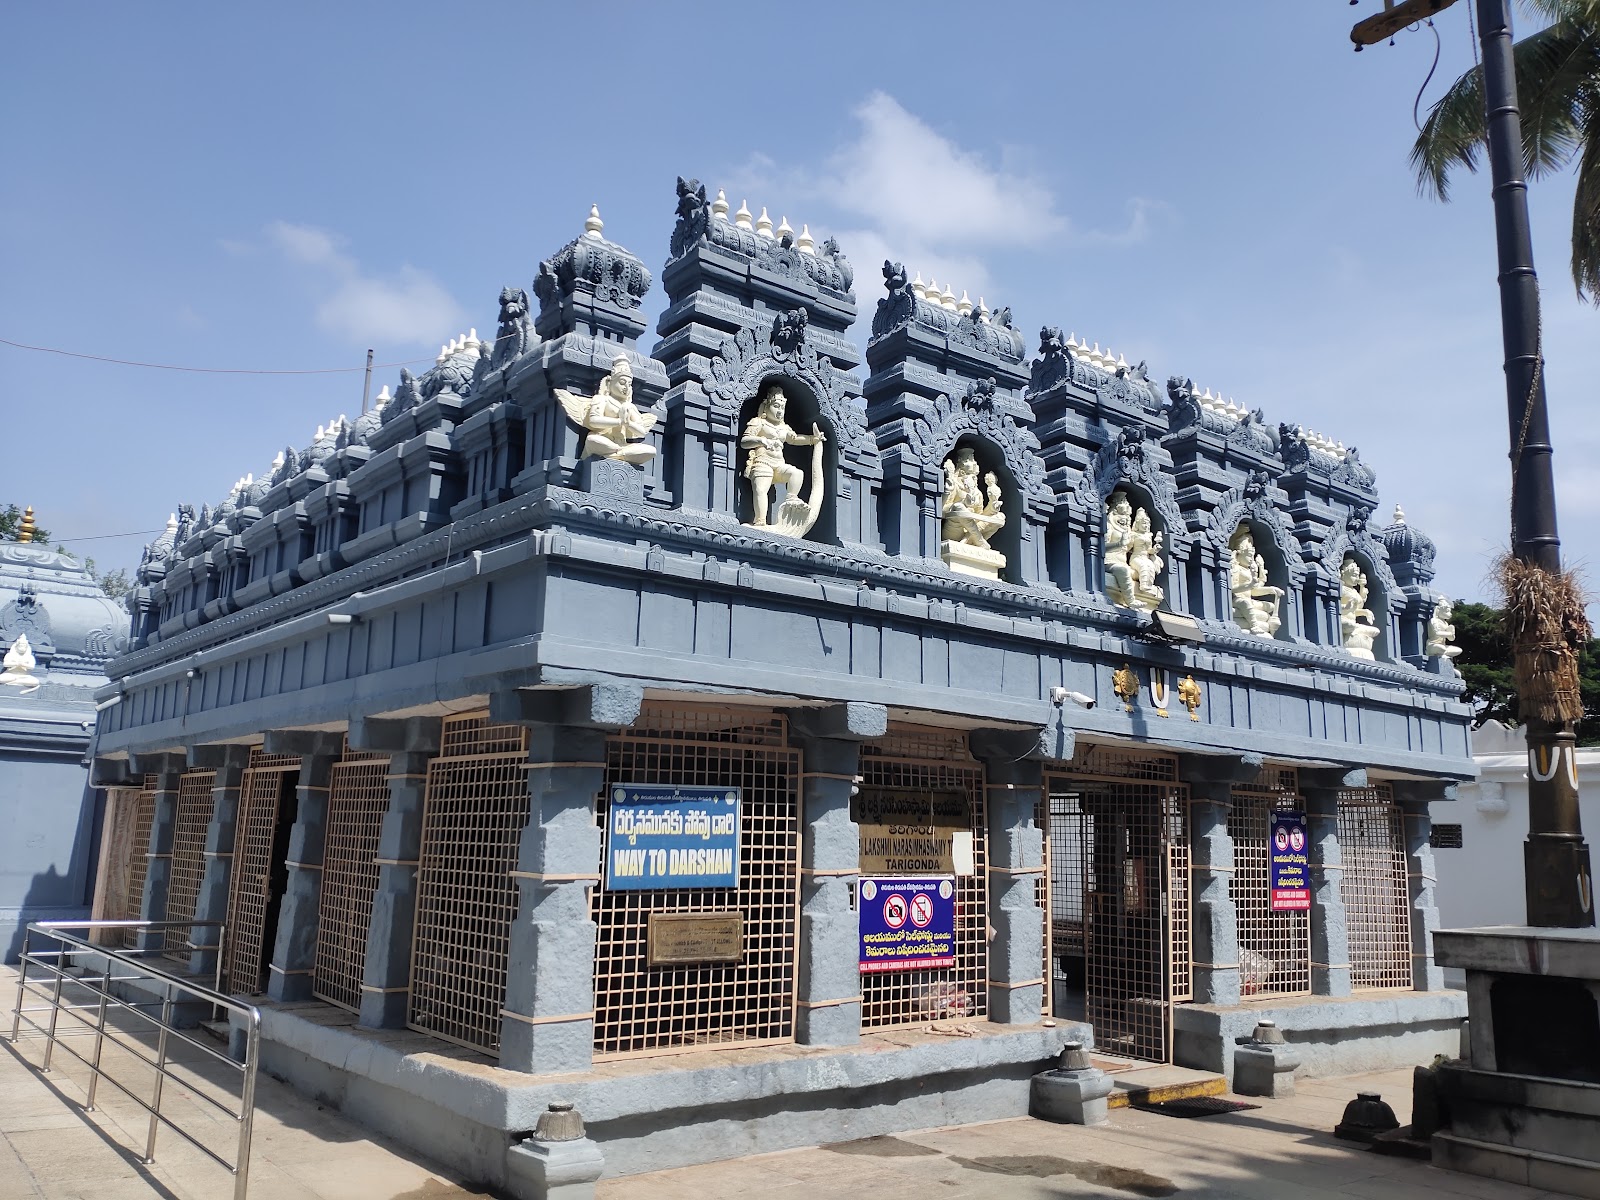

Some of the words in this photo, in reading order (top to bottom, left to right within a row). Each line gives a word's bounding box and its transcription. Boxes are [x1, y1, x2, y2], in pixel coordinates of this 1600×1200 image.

[614, 808, 683, 845] దర్శనమునకు
[684, 809, 711, 840] పోవు
[712, 812, 735, 835] దారి
[864, 838, 892, 856] LAKSHMI
[614, 849, 647, 877] WAY
[649, 849, 666, 876] TO
[669, 848, 733, 876] DARSHAN
[885, 858, 940, 870] TARIGONDA
[863, 929, 905, 943] ఆలయములో
